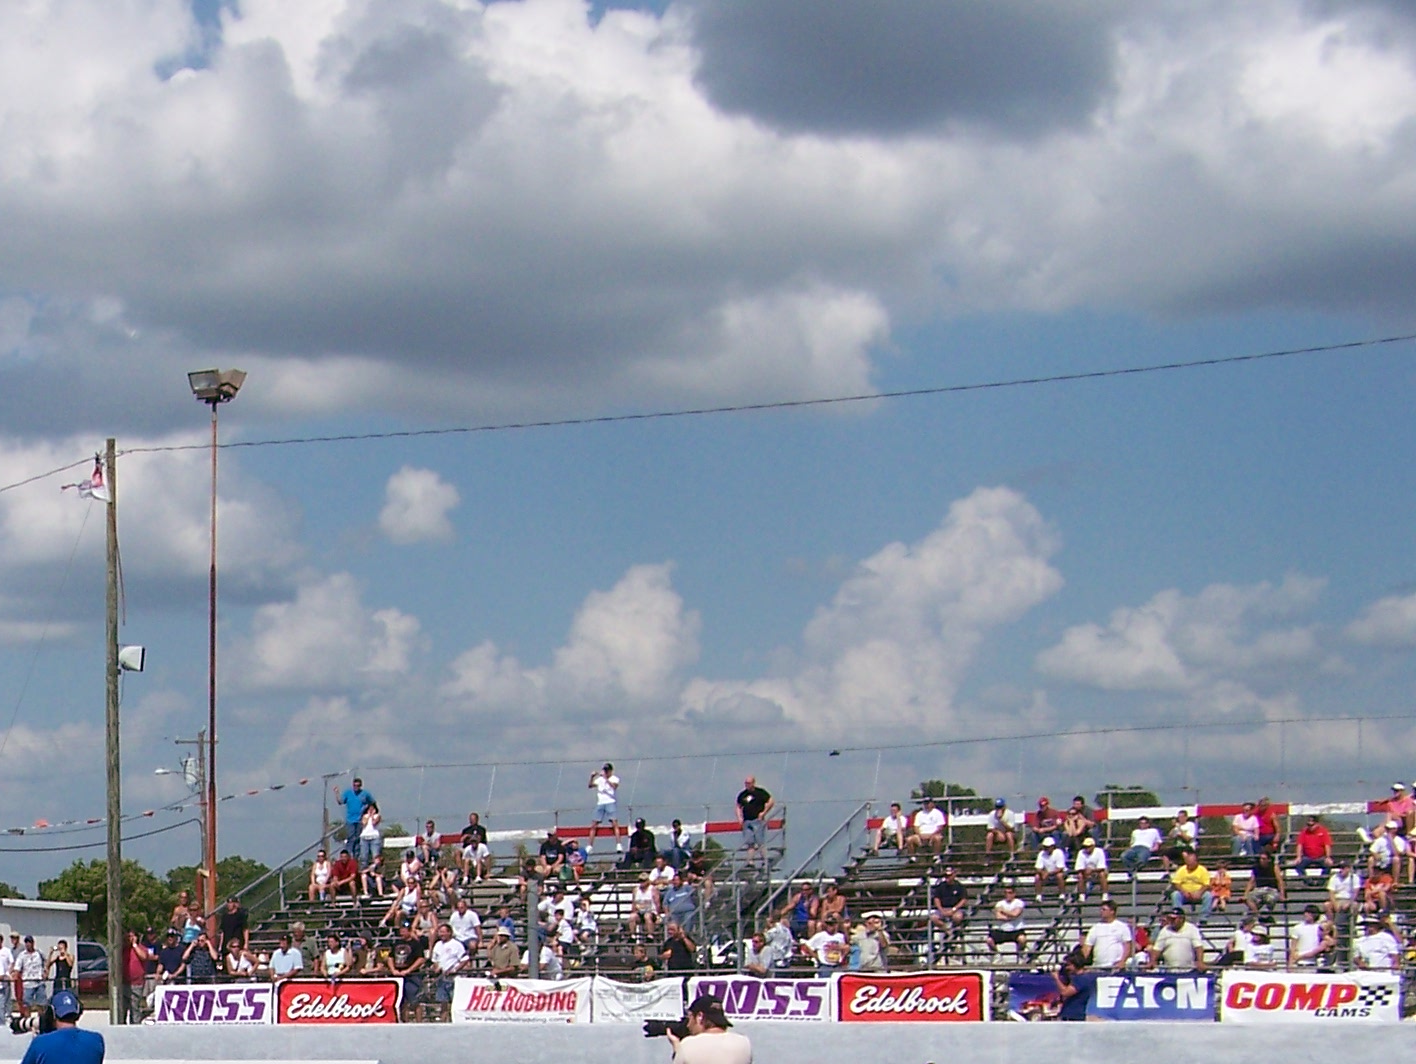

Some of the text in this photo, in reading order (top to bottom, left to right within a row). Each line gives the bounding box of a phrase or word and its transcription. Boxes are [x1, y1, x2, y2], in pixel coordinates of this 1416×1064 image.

[157, 988, 271, 1021] ROSS
[287, 993, 386, 1019] Edelbrock
[465, 986, 502, 1012] HOT
[850, 986, 968, 1014] Edelbrock
[1096, 977, 1208, 1010] EATON
[1226, 982, 1359, 1011] COMP
[1315, 1007, 1371, 1018] CAMS
